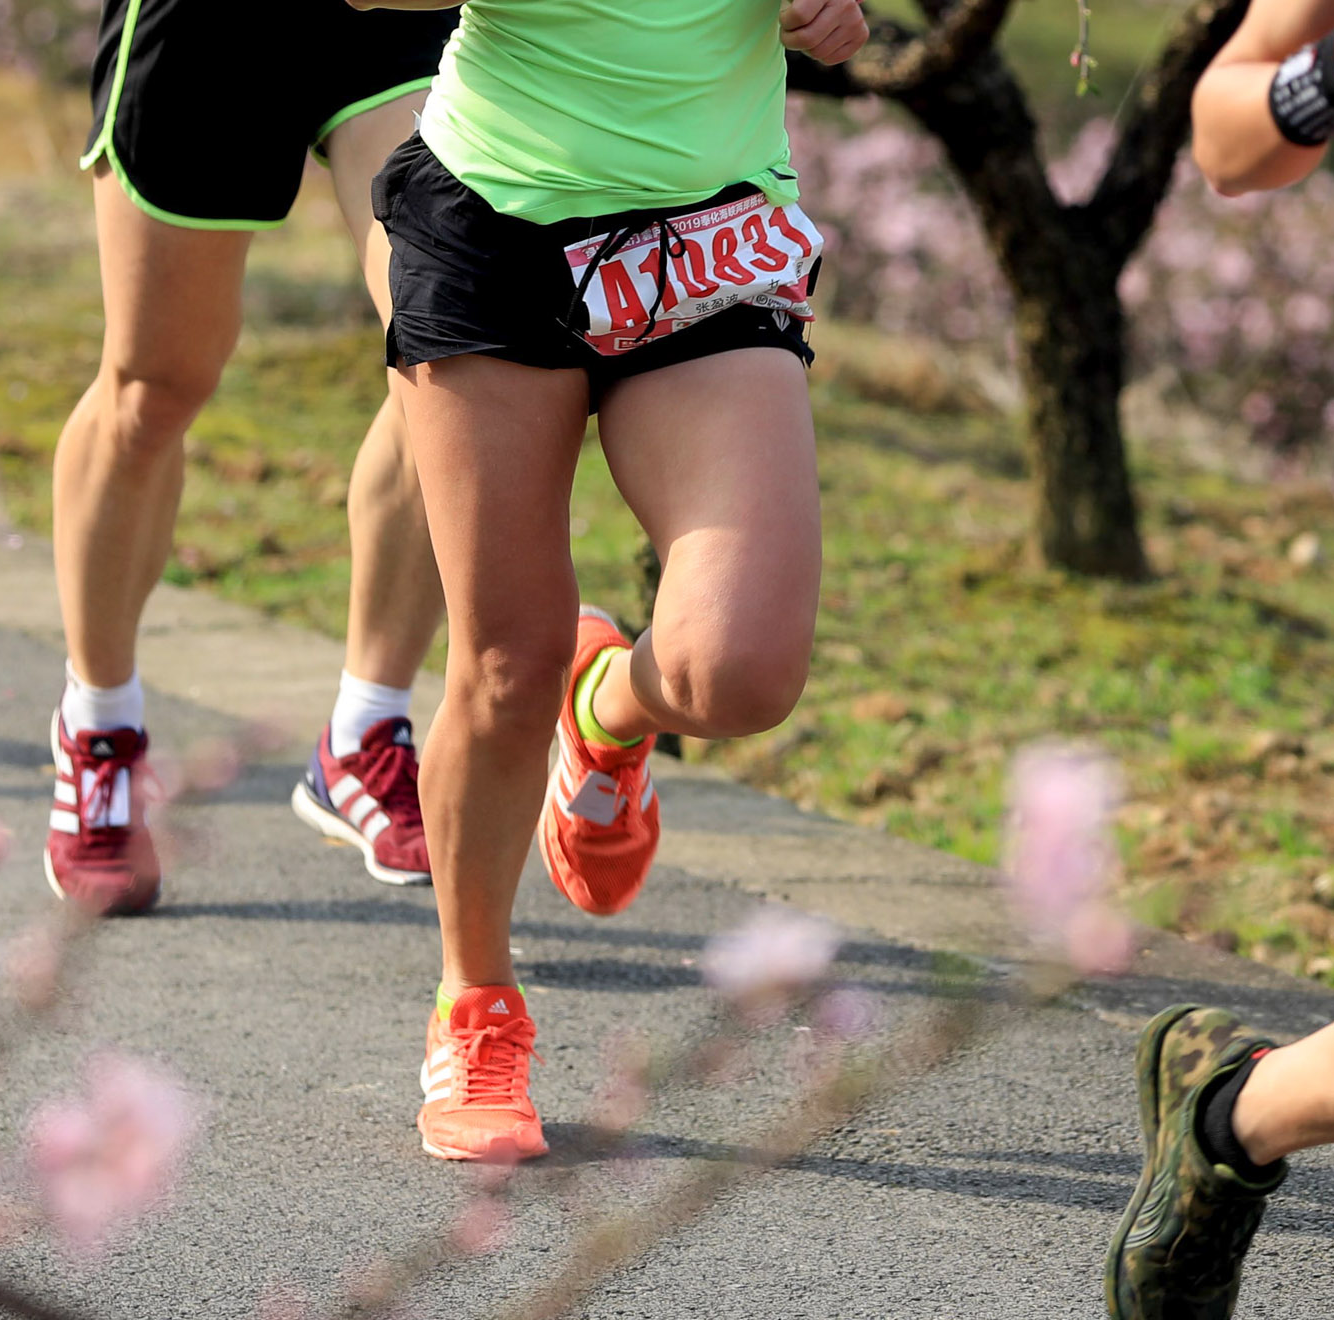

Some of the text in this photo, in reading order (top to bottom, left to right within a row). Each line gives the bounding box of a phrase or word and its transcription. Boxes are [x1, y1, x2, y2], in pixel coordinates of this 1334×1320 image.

[598, 206, 813, 331] A10831
[695, 293, 739, 314] 张盈波
